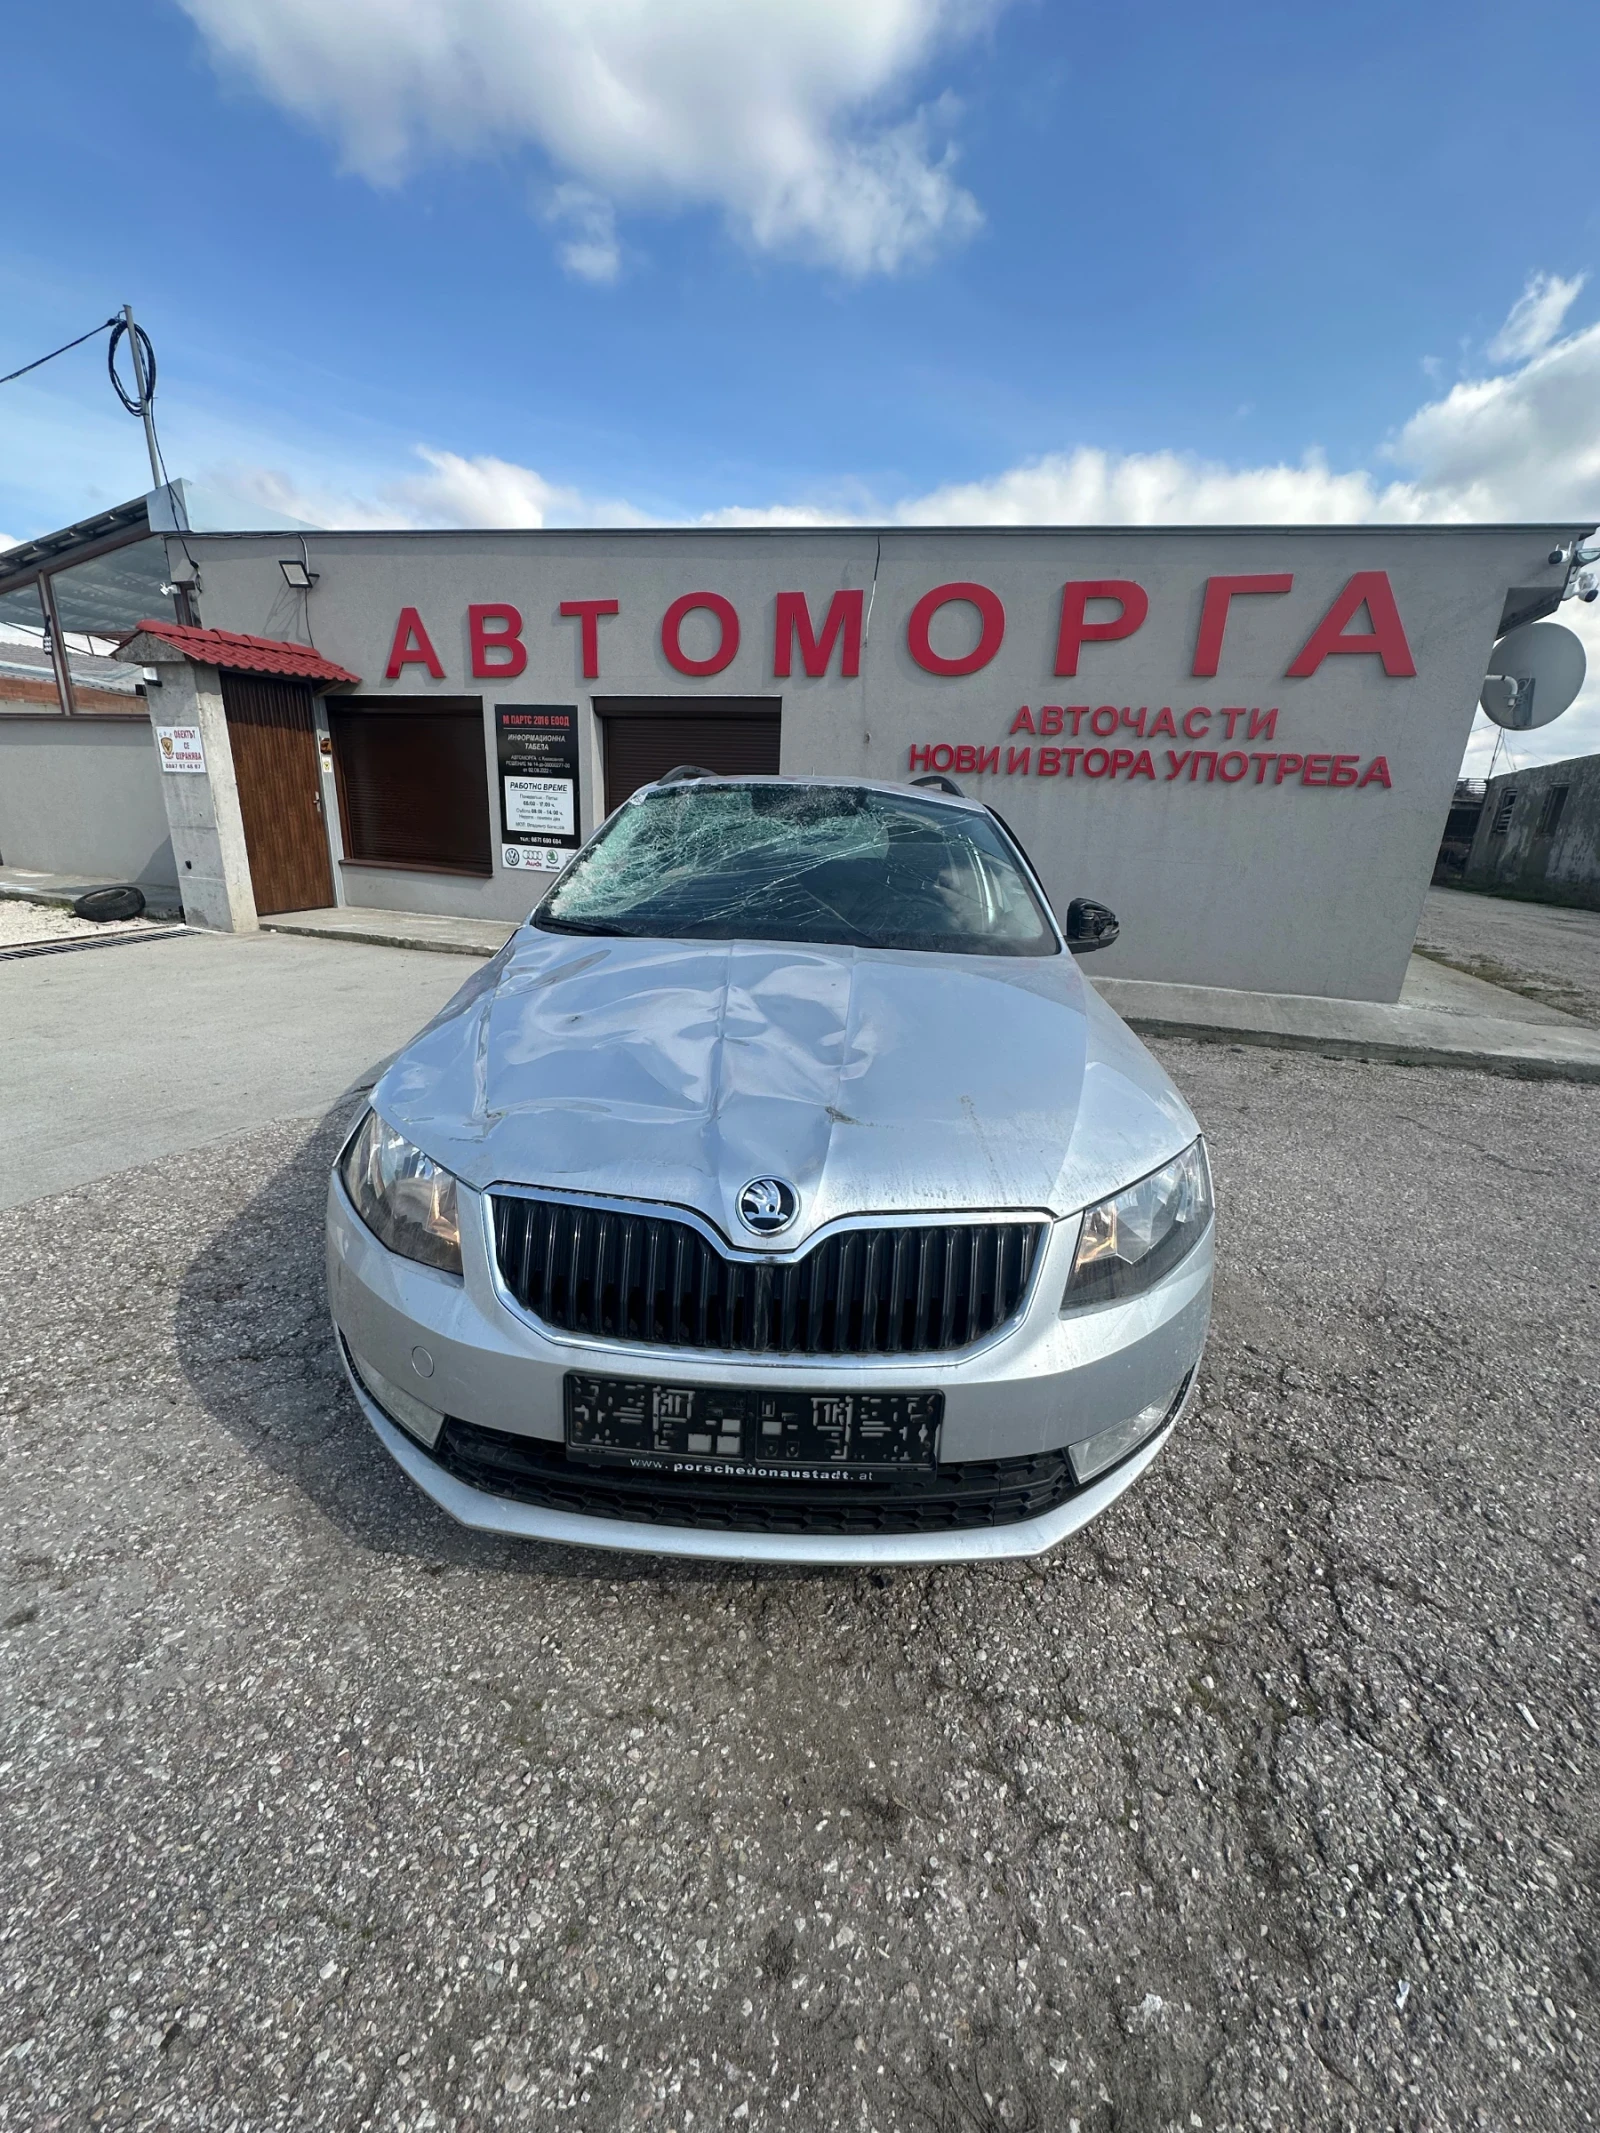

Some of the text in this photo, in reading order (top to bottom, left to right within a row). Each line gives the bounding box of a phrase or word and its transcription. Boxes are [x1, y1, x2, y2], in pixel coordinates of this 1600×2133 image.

[385, 571, 1417, 679] АВТОМОРГА
[510, 715, 532, 725] ПАРТС
[533, 715, 549, 725] 2016
[551, 716, 569, 726] ЕООД
[1009, 704, 1279, 740] АВТОЧАСТИ
[507, 733, 566, 742] ИНФОРМАЦИОННА
[183, 741, 190, 749] СЕ
[908, 742, 1393, 789] НОВИ И ВТОРА УПОТРЕБА
[510, 782, 568, 791] РАБОТНО ВРЕМЕ
